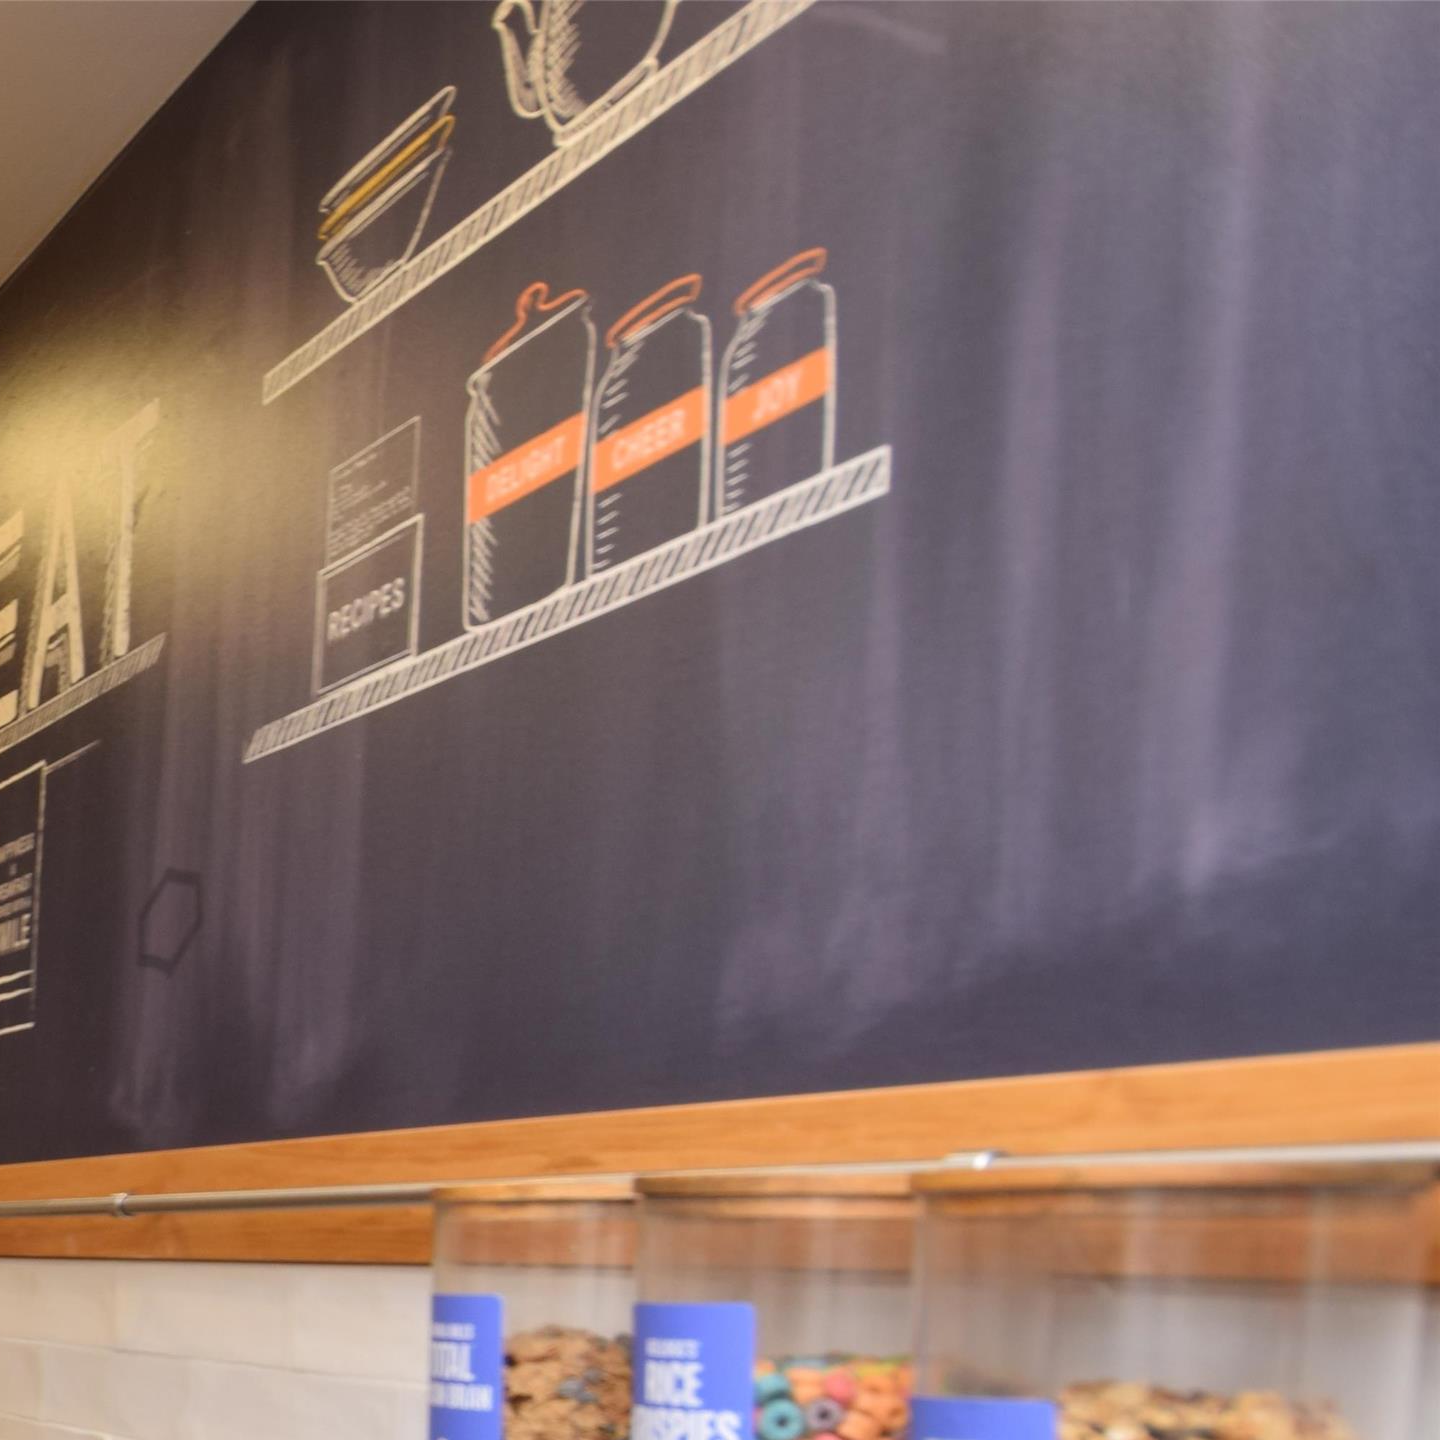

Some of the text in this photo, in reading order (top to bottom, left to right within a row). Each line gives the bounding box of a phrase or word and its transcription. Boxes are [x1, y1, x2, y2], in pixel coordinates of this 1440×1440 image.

[752, 368, 804, 421] JOY
[485, 435, 567, 503] DELIGHT
[611, 408, 686, 470] CHEER
[327, 576, 406, 644] RECIPES
